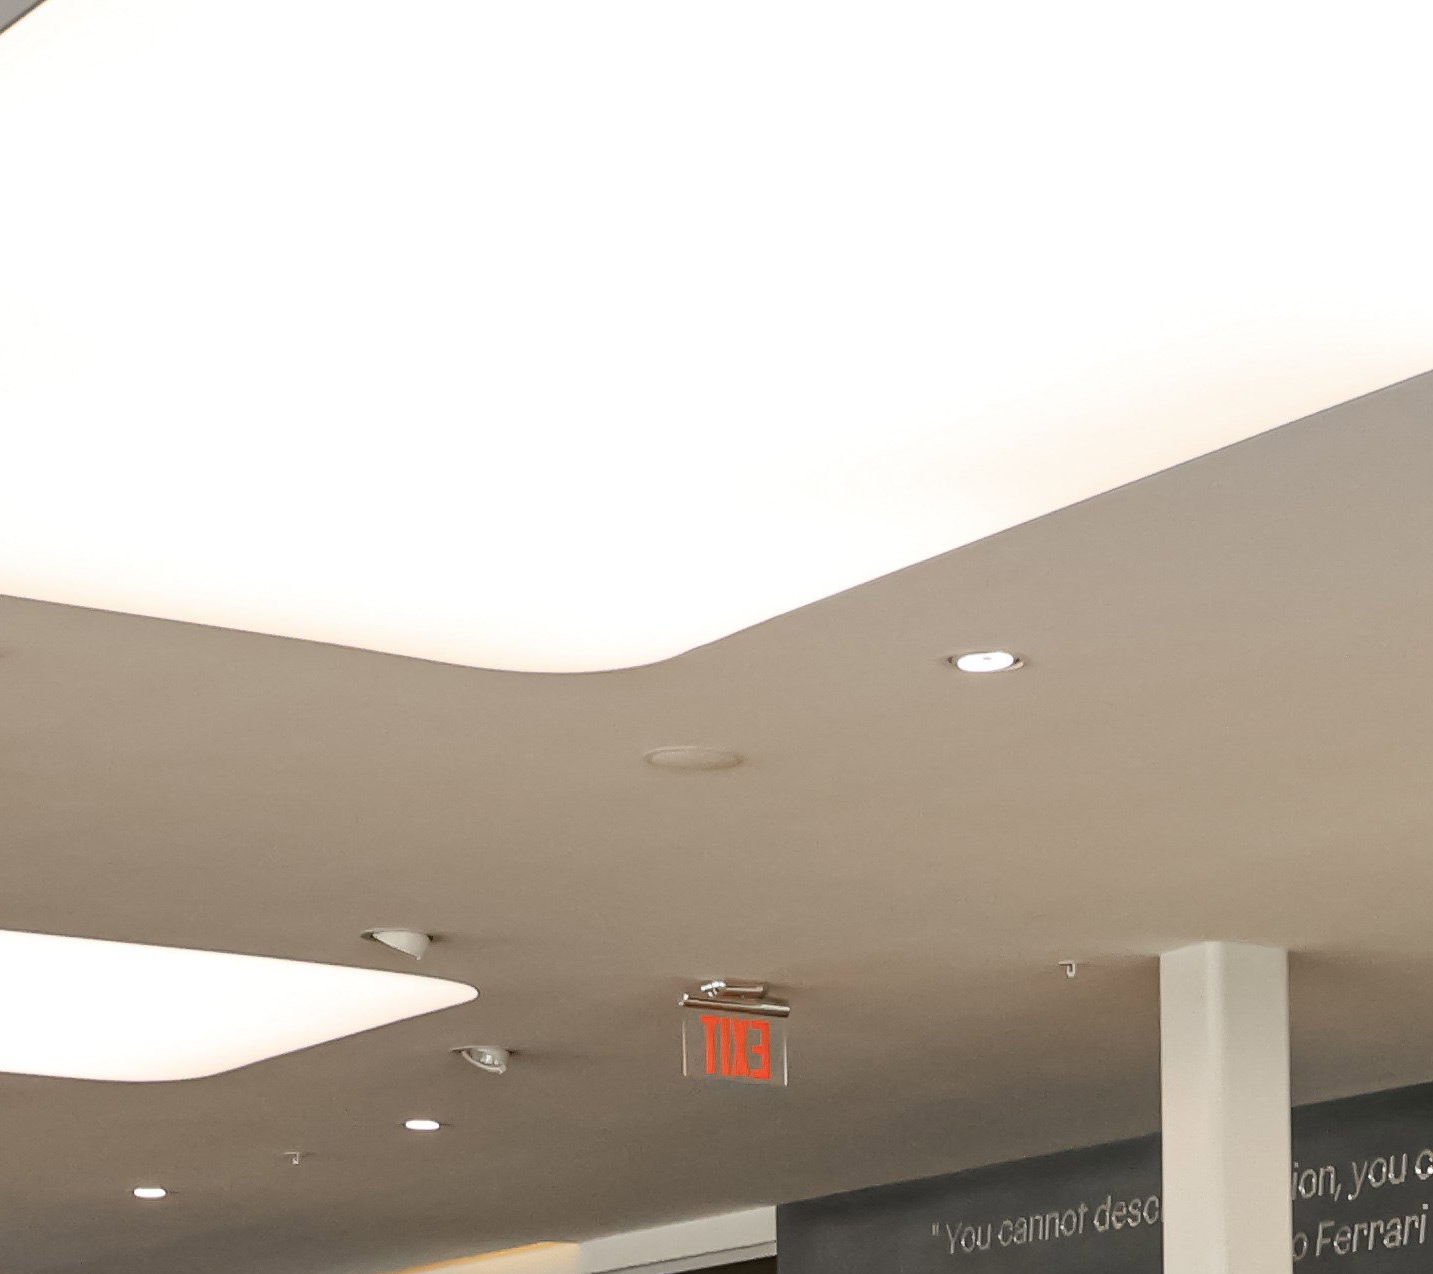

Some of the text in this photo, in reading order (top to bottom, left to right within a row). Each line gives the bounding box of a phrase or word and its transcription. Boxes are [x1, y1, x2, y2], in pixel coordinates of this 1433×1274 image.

[997, 1202, 1089, 1247] cannot
[1093, 1194, 1160, 1233] desc
[1291, 1161, 1342, 1202] ion,
[1347, 1152, 1408, 1201] you
[1315, 1202, 1430, 1258] Ferrari
